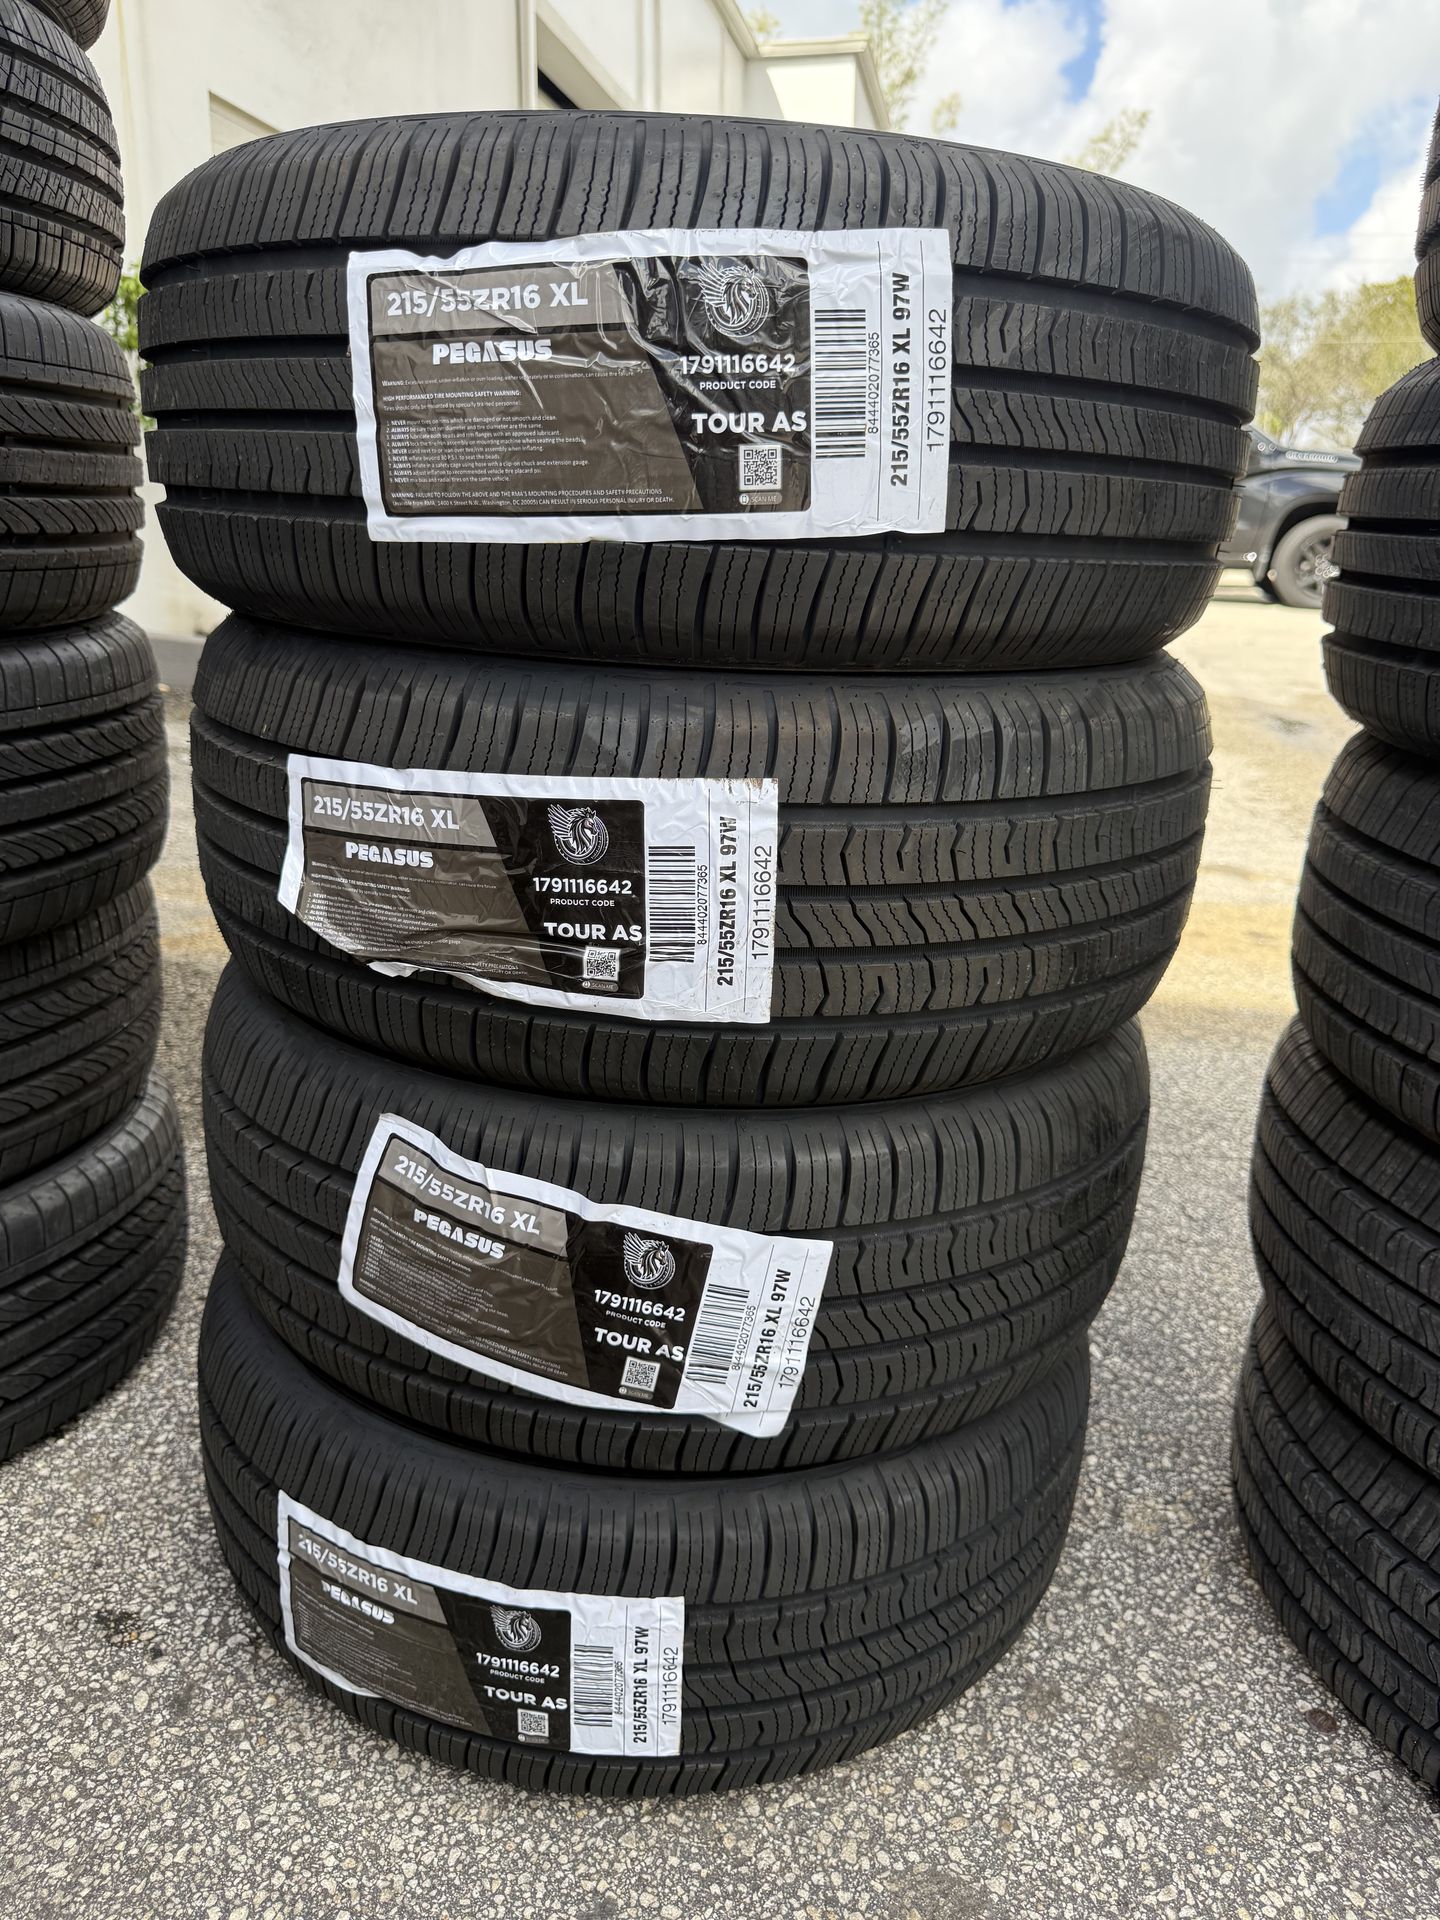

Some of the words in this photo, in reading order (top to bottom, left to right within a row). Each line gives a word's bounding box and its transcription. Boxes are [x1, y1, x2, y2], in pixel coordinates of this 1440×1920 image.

[387, 286, 541, 317] 215/55ZR16
[549, 282, 588, 307] XL
[892, 272, 910, 320] 97W
[432, 340, 552, 365] PEGASUS
[892, 328, 911, 354] XL
[680, 354, 796, 374] 1791116642
[928, 309, 946, 452] 1791116642
[700, 381, 746, 390] PRODUCT
[749, 380, 776, 390] CODE
[868, 332, 880, 434] 844402077365
[691, 412, 764, 434] TOUR
[773, 412, 807, 432] AS
[890, 362, 910, 487] 215/55ZR16
[314, 795, 425, 826] 215/55ZR16
[430, 808, 460, 830] XL
[720, 816, 737, 856] 97W
[346, 842, 434, 868] PEGASUS
[720, 861, 737, 883] XL
[532, 878, 632, 894] 1791116642
[550, 898, 590, 906] PRODUCT
[752, 846, 772, 960] 1791116642
[696, 864, 708, 945] 844402077365
[544, 923, 606, 940] TOUR
[612, 926, 642, 942] AS
[717, 888, 736, 986] 215/55ZR16
[394, 1155, 506, 1224] 215/55ZR16
[510, 1210, 540, 1236] XL
[414, 1208, 506, 1258] PEGASUS
[770, 1268, 792, 1302] 97W
[594, 1289, 686, 1322] 1791116642
[606, 1310, 642, 1324] PRODUCT
[644, 1318, 666, 1329] CODE
[764, 1306, 783, 1325] XL
[594, 1327, 652, 1354] TOUR
[656, 1344, 684, 1362] AS
[778, 1296, 816, 1389] 1791116642
[743, 1328, 776, 1408] 215/55ZR16
[298, 1534, 389, 1593] 215/55ZR16
[393, 1582, 418, 1605] XL
[321, 1580, 395, 1624] PEGASUS
[635, 1626, 650, 1657] 97W
[476, 1652, 560, 1678] 1791116642
[490, 1669, 524, 1680] PRODUCT
[524, 1676, 545, 1684] CODE
[634, 1660, 648, 1676] XL
[484, 1686, 536, 1706] TOUR
[542, 1696, 568, 1710] AS
[662, 1646, 679, 1726] 1791116642
[633, 1678, 648, 1744] 215/55ZR16
